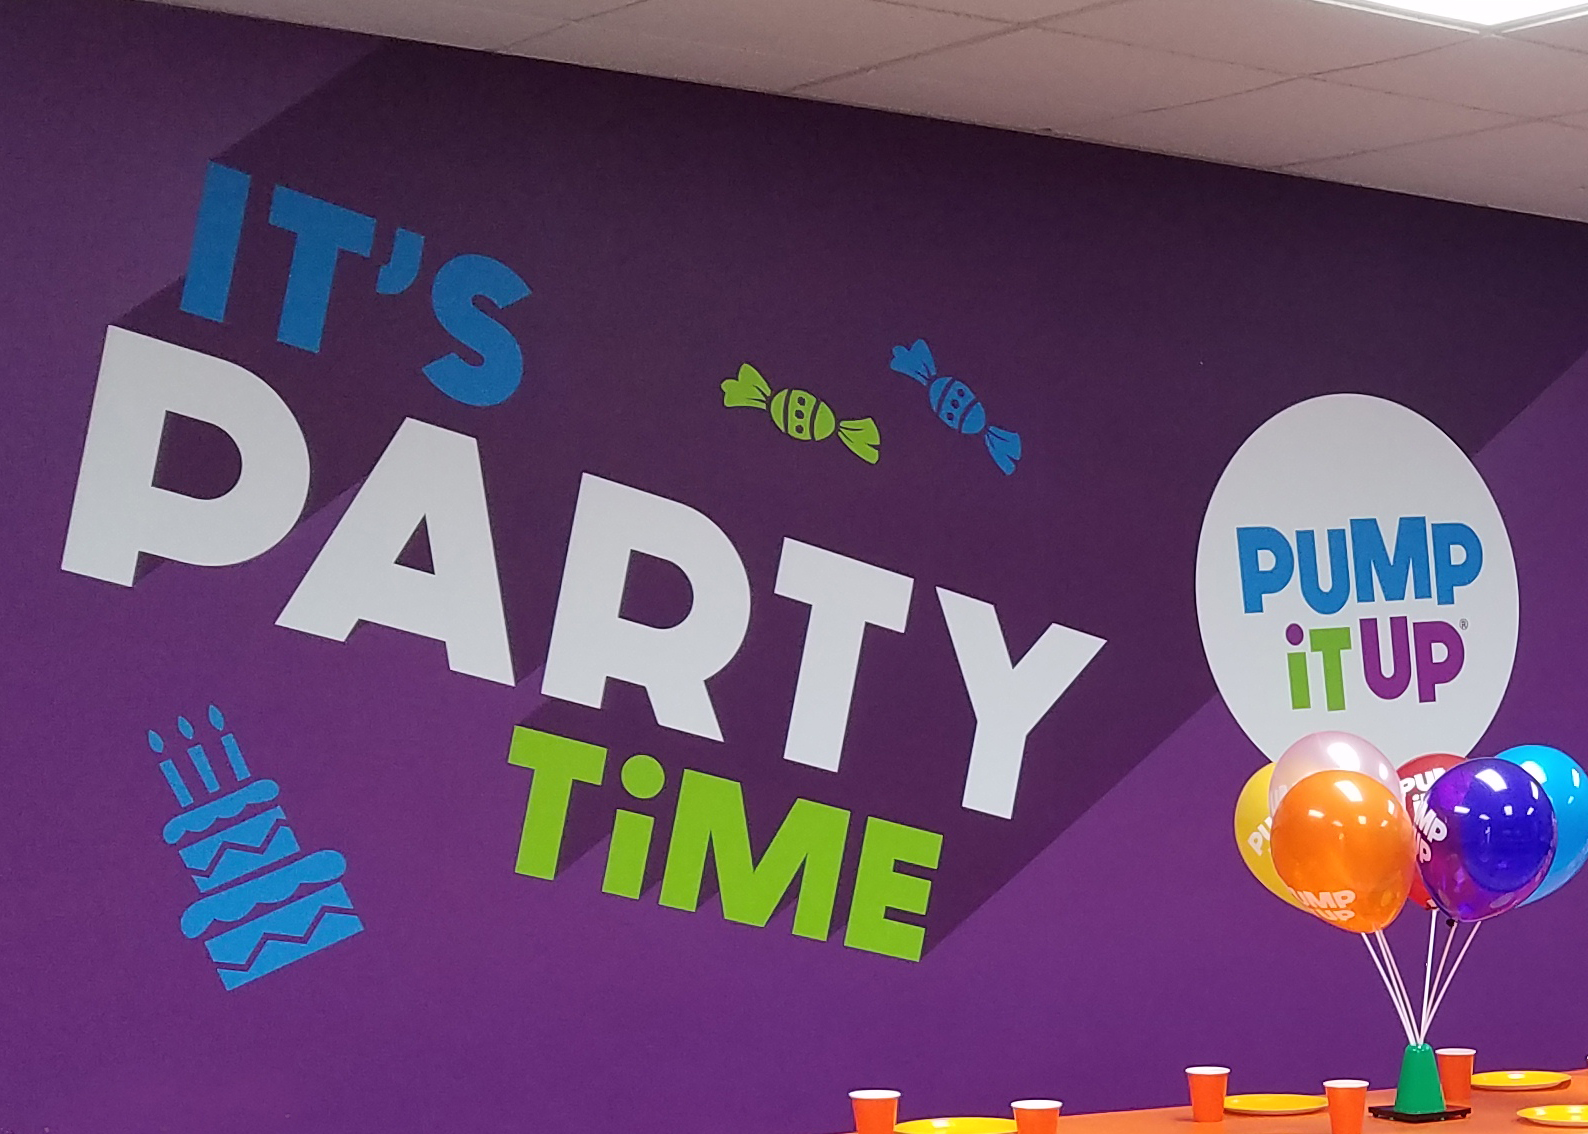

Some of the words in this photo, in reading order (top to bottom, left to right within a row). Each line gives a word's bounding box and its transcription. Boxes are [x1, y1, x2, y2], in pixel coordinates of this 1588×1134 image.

[60, 324, 1107, 819] PARTY
[1235, 515, 1484, 615] PUMP
[1400, 767, 1446, 794] PU
[1248, 817, 1273, 857] PU
[1287, 886, 1356, 909] UMP
